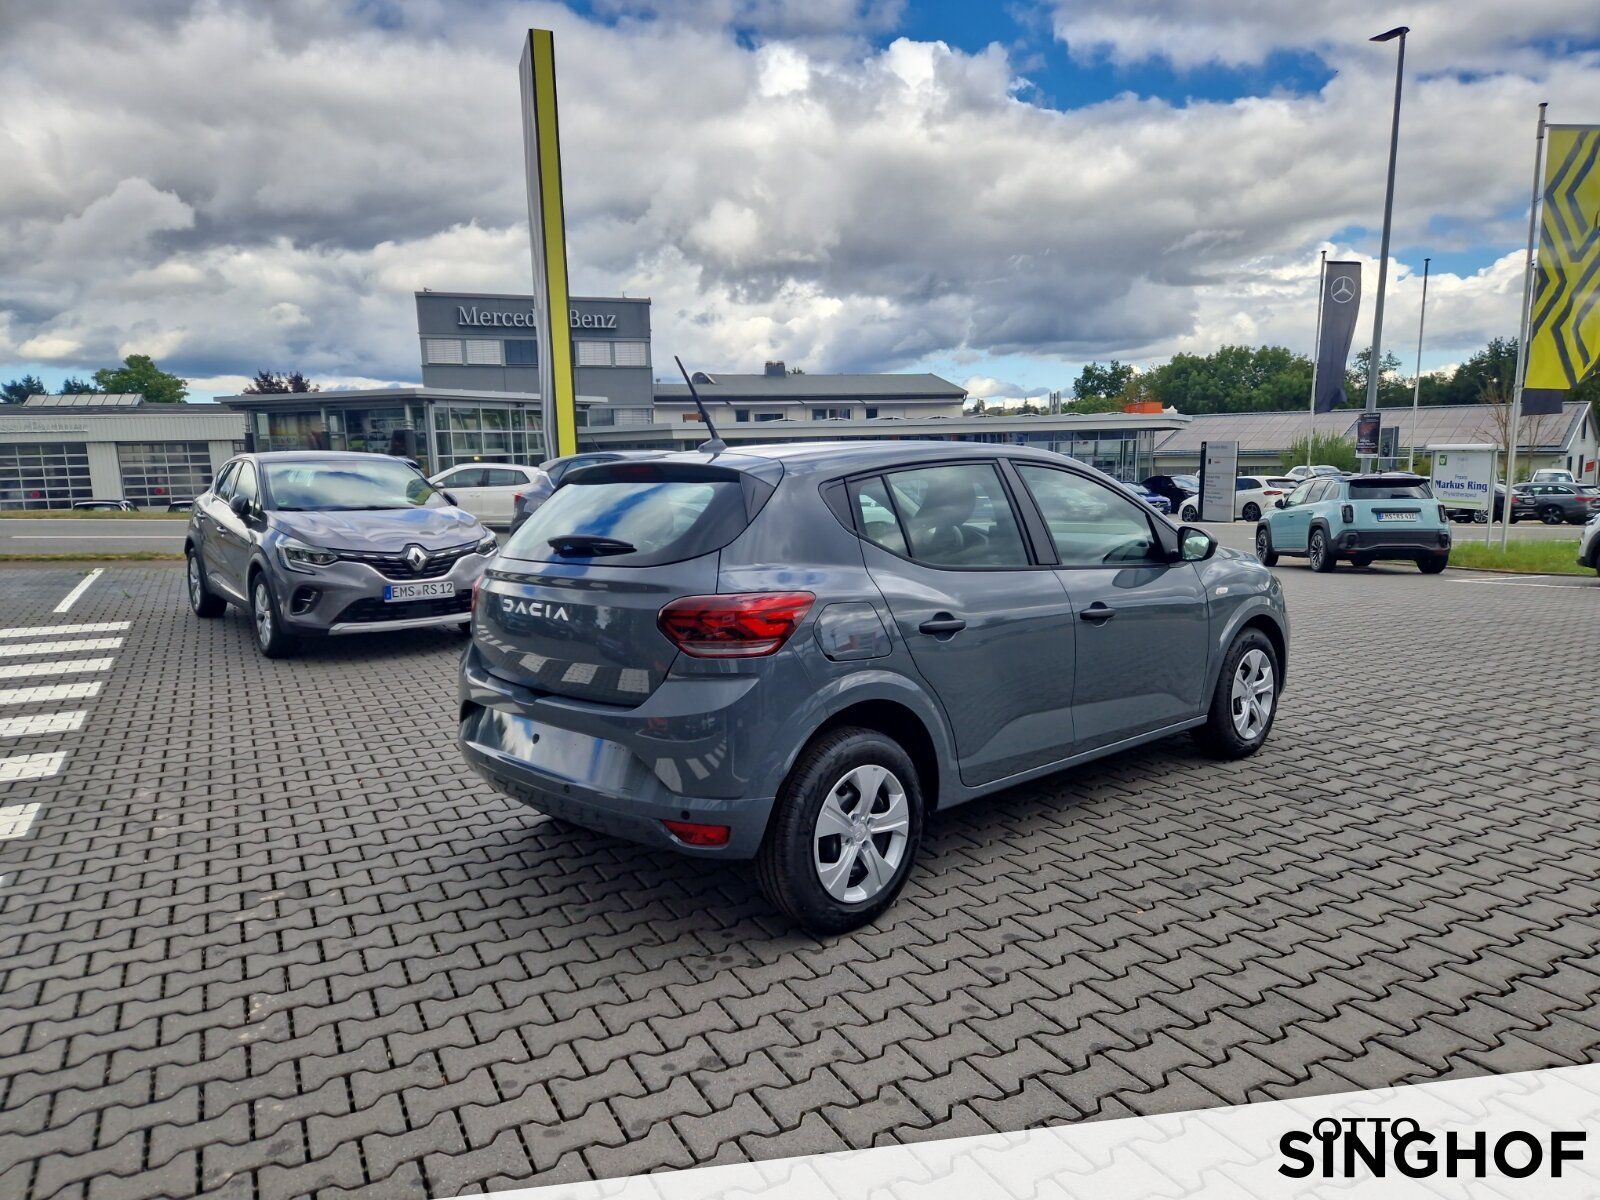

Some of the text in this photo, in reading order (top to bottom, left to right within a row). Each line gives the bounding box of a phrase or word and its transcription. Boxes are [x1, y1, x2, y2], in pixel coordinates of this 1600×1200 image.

[1435, 480, 1488, 493] Markus Ring
[392, 582, 453, 598] EMS RS 12
[502, 598, 569, 622] DACIA
